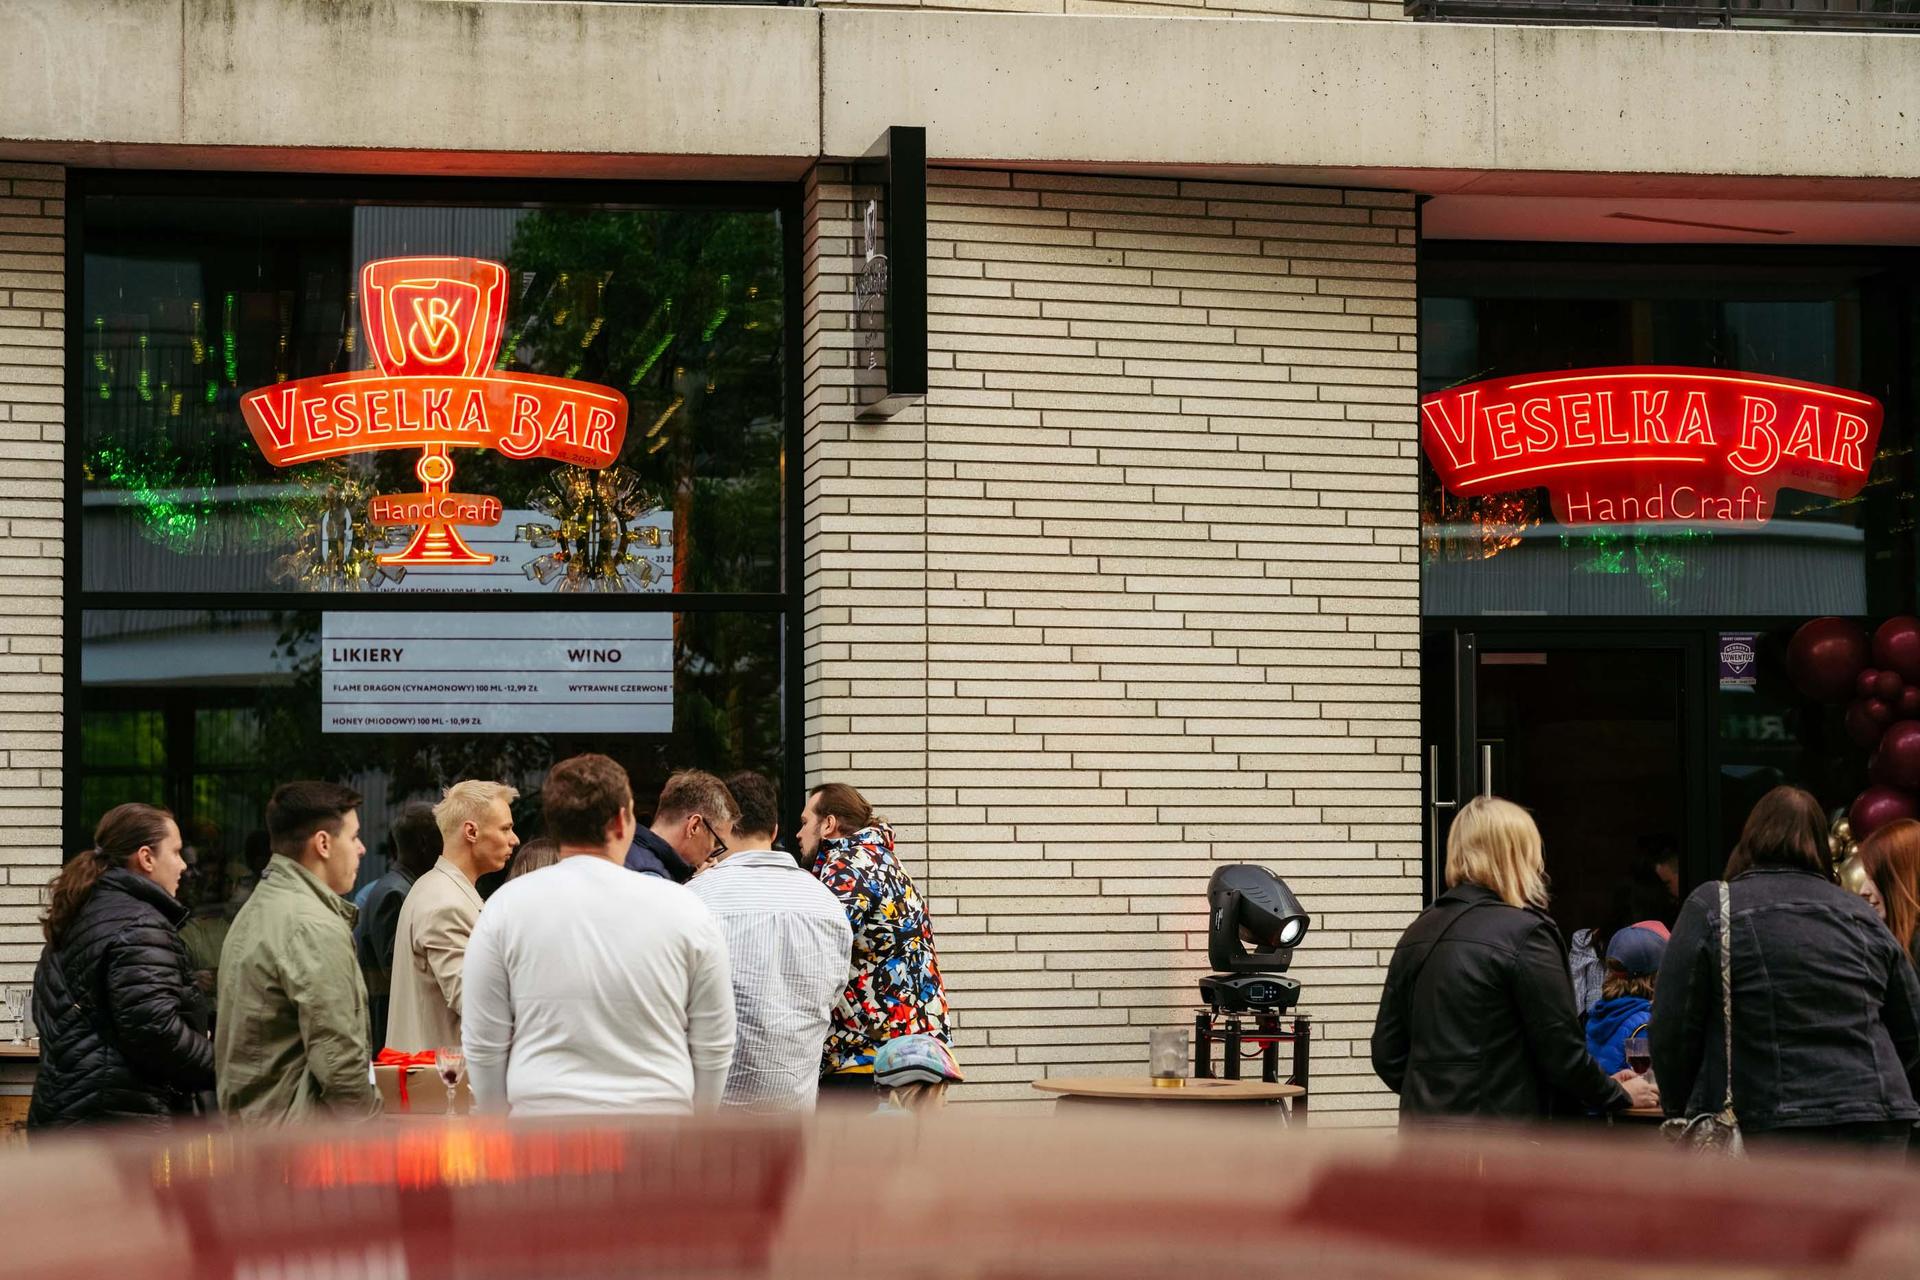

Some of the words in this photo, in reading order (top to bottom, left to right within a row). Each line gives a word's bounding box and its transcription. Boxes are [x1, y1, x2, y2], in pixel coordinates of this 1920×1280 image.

[249, 387, 492, 449] VESELKA
[499, 392, 616, 457] BAR
[1421, 389, 1717, 470] VESELKA
[1727, 394, 1870, 476] BAR
[572, 453, 598, 466] 2024
[373, 496, 500, 522] HandCraft
[1566, 483, 1768, 523] HandCraft
[332, 647, 404, 662] LIKIERY
[567, 648, 622, 663] WINO
[333, 684, 361, 692] FLAME
[363, 684, 401, 692] DRAGON
[402, 683, 475, 693] (CYNAMONOWY)
[476, 684, 489, 692] 100
[490, 684, 503, 692] ML
[568, 684, 619, 692] WYTRAWNE
[620, 684, 668, 692] CZERWONE
[332, 717, 364, 726] HONEY
[365, 717, 416, 727] (MIODOWY)
[417, 717, 430, 726] 100
[431, 717, 444, 726] ML
[450, 717, 470, 727] 10,99
